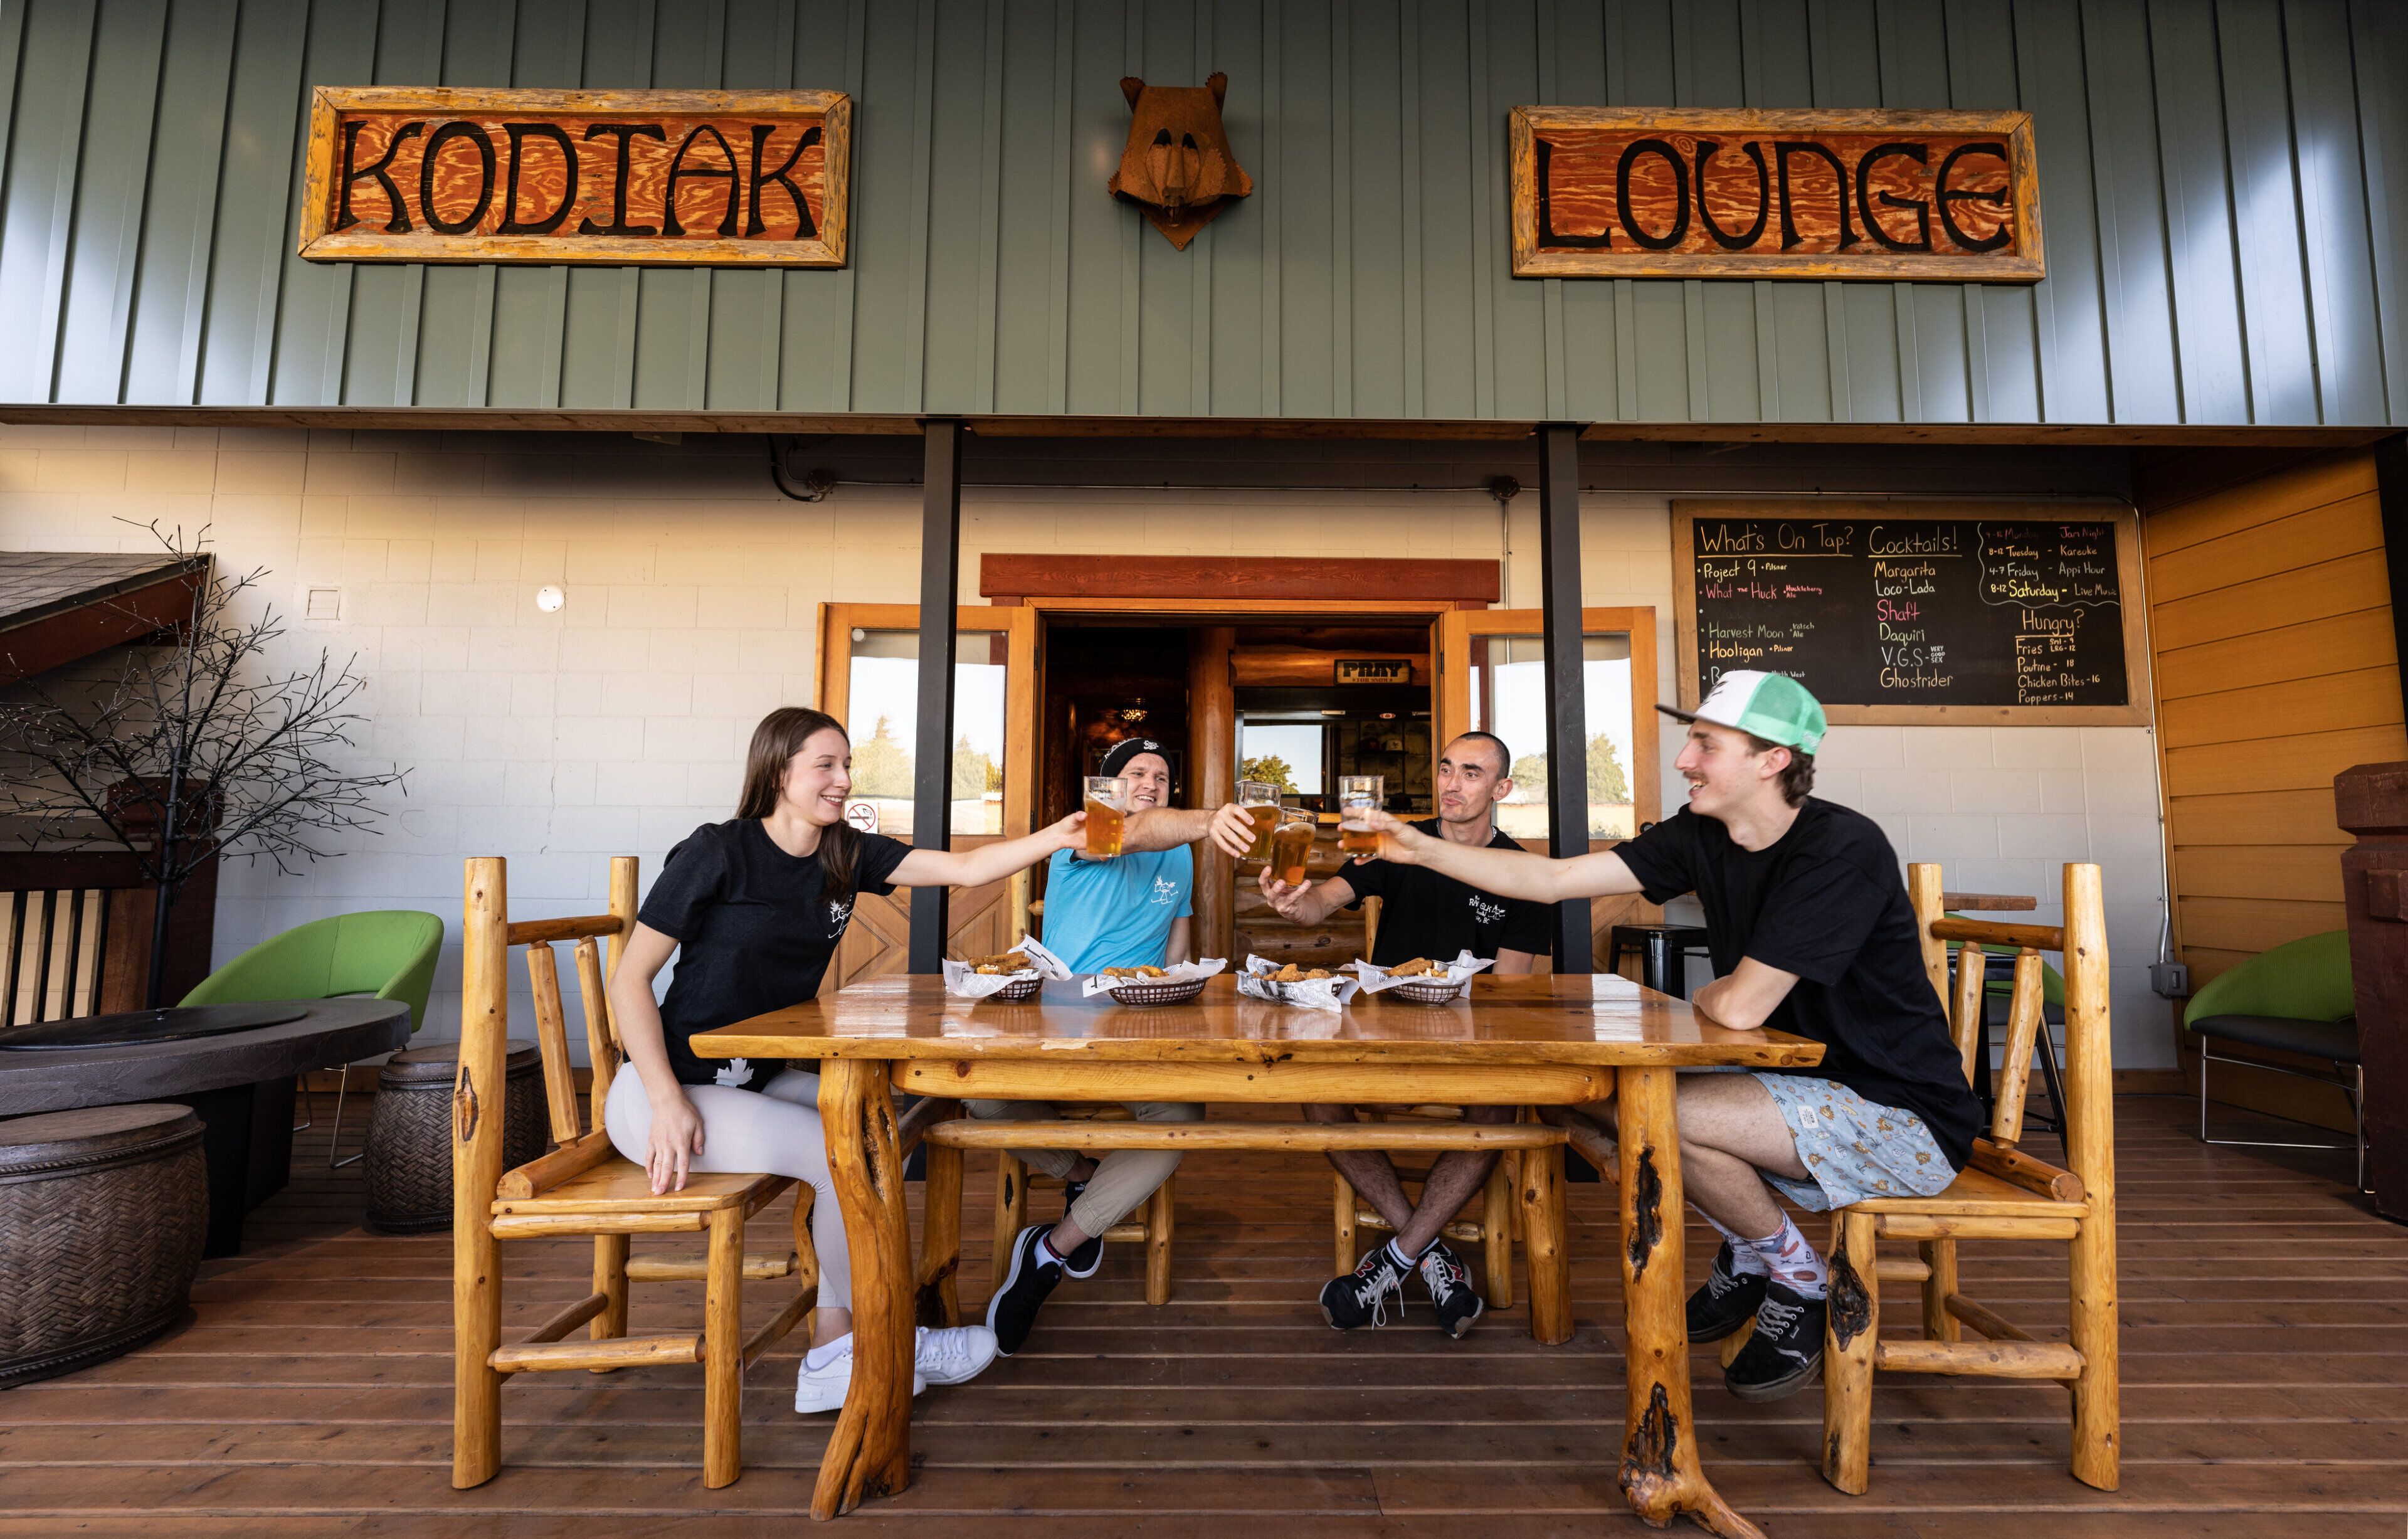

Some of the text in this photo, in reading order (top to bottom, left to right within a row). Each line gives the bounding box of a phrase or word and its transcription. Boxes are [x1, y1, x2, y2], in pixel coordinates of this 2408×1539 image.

[335, 121, 822, 237] KODIAK
[1536, 139, 2012, 250] LOUNGE
[1701, 522, 1854, 553] What's On Tap?
[1869, 526, 1957, 554] Cocktails!
[2005, 528, 2039, 541] Monday
[2059, 526, 2079, 539] Jam
[2082, 526, 2104, 540] Night
[2006, 545, 2038, 560] Tuesday
[2060, 544, 2097, 556] Kareoke
[1704, 560, 1740, 583] Project
[1748, 559, 1755, 576] 9
[1874, 561, 1936, 583] Margarita
[1989, 566, 2005, 575] 4-7
[2008, 562, 2039, 581] Friday
[2059, 561, 2081, 578] Appi
[2084, 561, 2105, 574] Hour
[1706, 583, 1733, 599] What
[1751, 582, 1777, 599] Huck
[1786, 584, 1822, 595] Huckleberry
[1876, 578, 1935, 596] Loco-Lada
[1990, 584, 2007, 593] 8-12
[2009, 579, 2059, 602] Saturday
[2074, 583, 2093, 596] Live
[2095, 583, 2117, 596] Music
[1877, 599, 1921, 621] Shaft
[1709, 621, 1784, 639] Harvest Moon
[2023, 609, 2084, 637] Hungry?
[1879, 622, 1925, 647] Daquiri
[1710, 640, 1793, 664] Hooligan Pilsner
[2016, 638, 2042, 655] Fries
[1343, 662, 1402, 677] PRAY
[2017, 657, 2051, 673] Poutine
[2067, 659, 2074, 667] 18
[1881, 667, 1953, 689] Ghostrider
[2018, 675, 2057, 688] Chicken
[2061, 673, 2084, 687] Bites
[2019, 689, 2057, 706] Poppers
[1480, 902, 1492, 912] ELK
